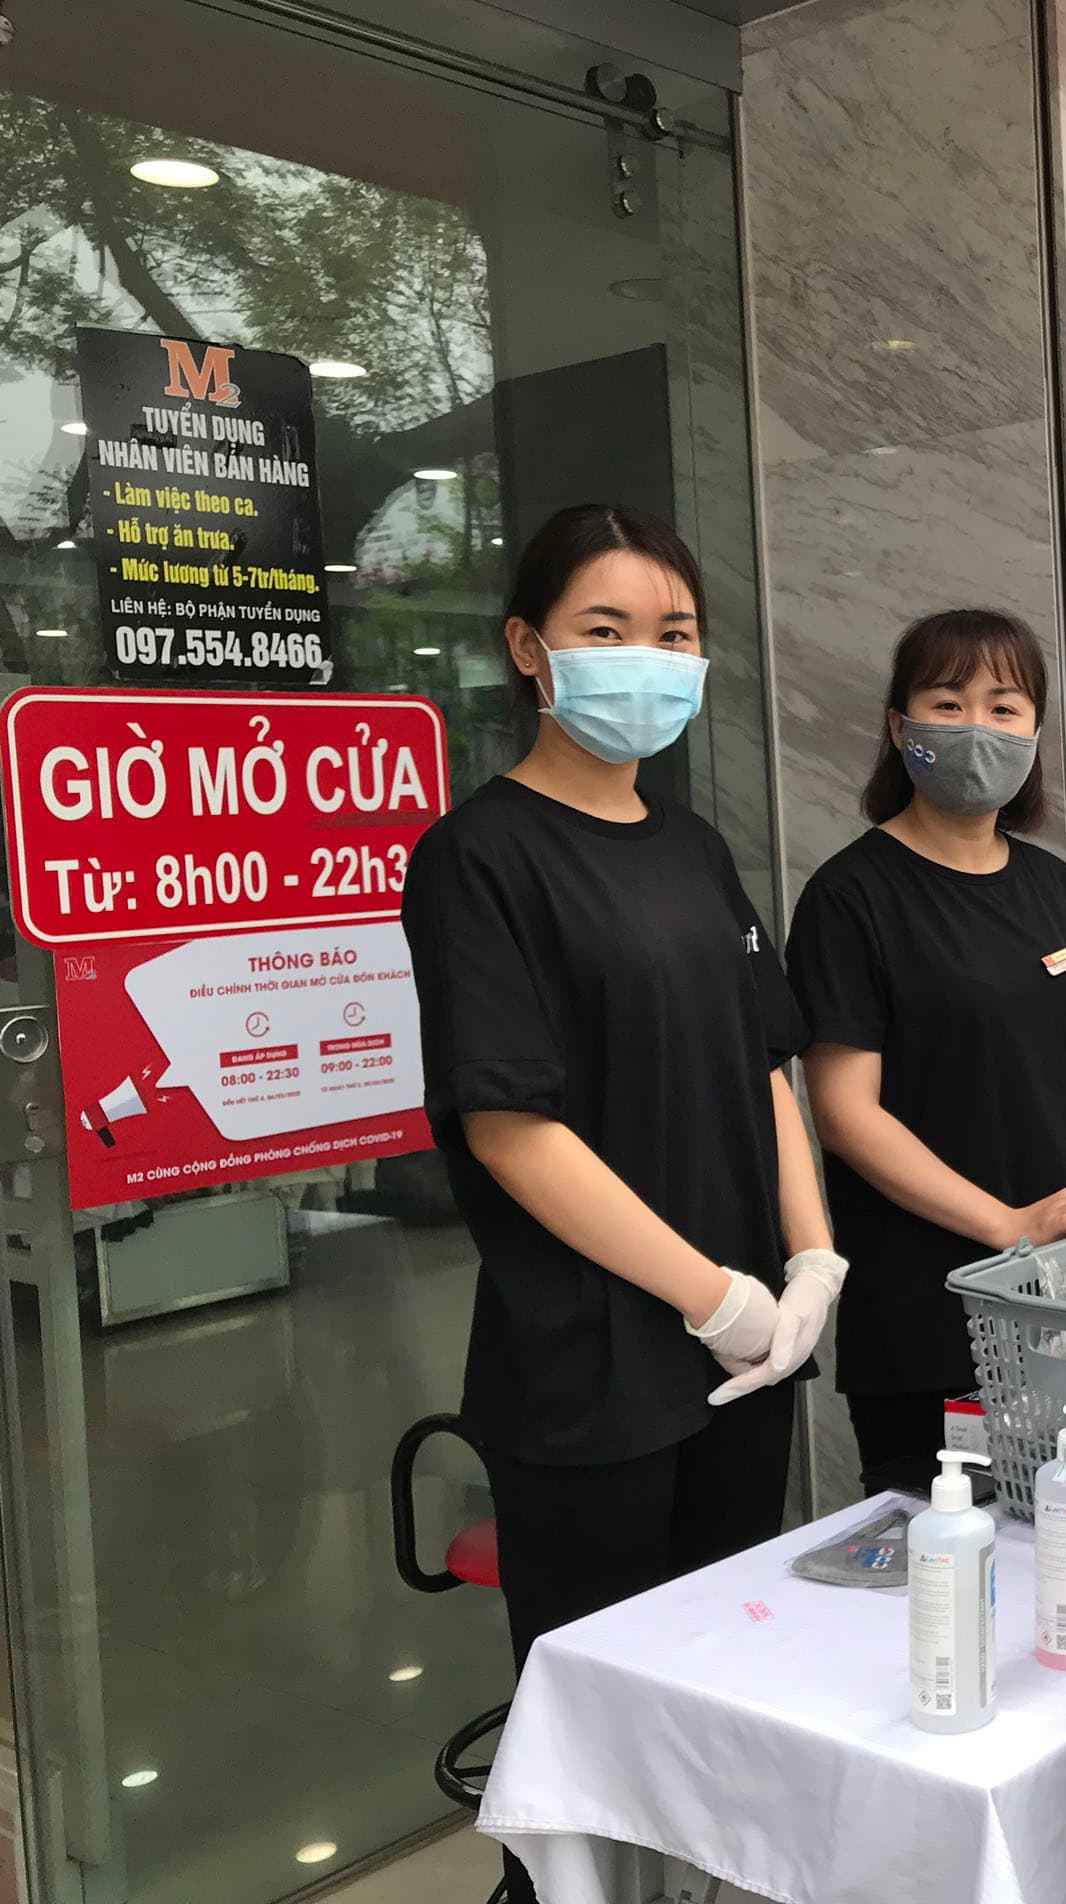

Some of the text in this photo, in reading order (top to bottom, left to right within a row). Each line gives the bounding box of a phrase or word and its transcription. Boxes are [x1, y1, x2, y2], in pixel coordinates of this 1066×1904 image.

[142, 402, 265, 450] TUYỂN DỤNG
[98, 438, 310, 487] NHÂN VIÊN BÁN HÀNG
[114, 481, 152, 507] Làm
[155, 487, 191, 514] việc
[194, 490, 230, 514] theo
[234, 497, 259, 517] ca.
[118, 517, 141, 543] Hỗ
[145, 523, 169, 550] trợ
[173, 523, 194, 547] ăn
[197, 527, 235, 551] trưa.
[121, 558, 159, 582] Mức
[163, 560, 209, 588] lương
[213, 563, 229, 586] từ
[232, 566, 320, 594] 5-7tr/tháng.
[111, 597, 321, 625] LIÊN HỆ: BỘ PHẬN TUYỂN DỤNG
[115, 625, 322, 669] 097.554.8466
[39, 714, 429, 821] GIỜ MỞ CỬA
[44, 857, 137, 915] Từ:
[155, 850, 269, 909] 8h00
[310, 843, 408, 898] 22h3
[247, 946, 358, 972] THÔNG BÁO
[189, 968, 411, 998] ĐIỀU CHỈNH THỜI GIAN MỞ CỬA ĐÓN KHÁCH
[221, 1073, 256, 1087] 08:00
[266, 1067, 300, 1081] 22:30
[320, 1061, 352, 1074] 09:00
[362, 1055, 393, 1069] 22:00
[127, 1129, 403, 1184] M2 CÙNG CỘNG ĐỒNG PHÒNG CHỐNG DỊCH COVID-19
